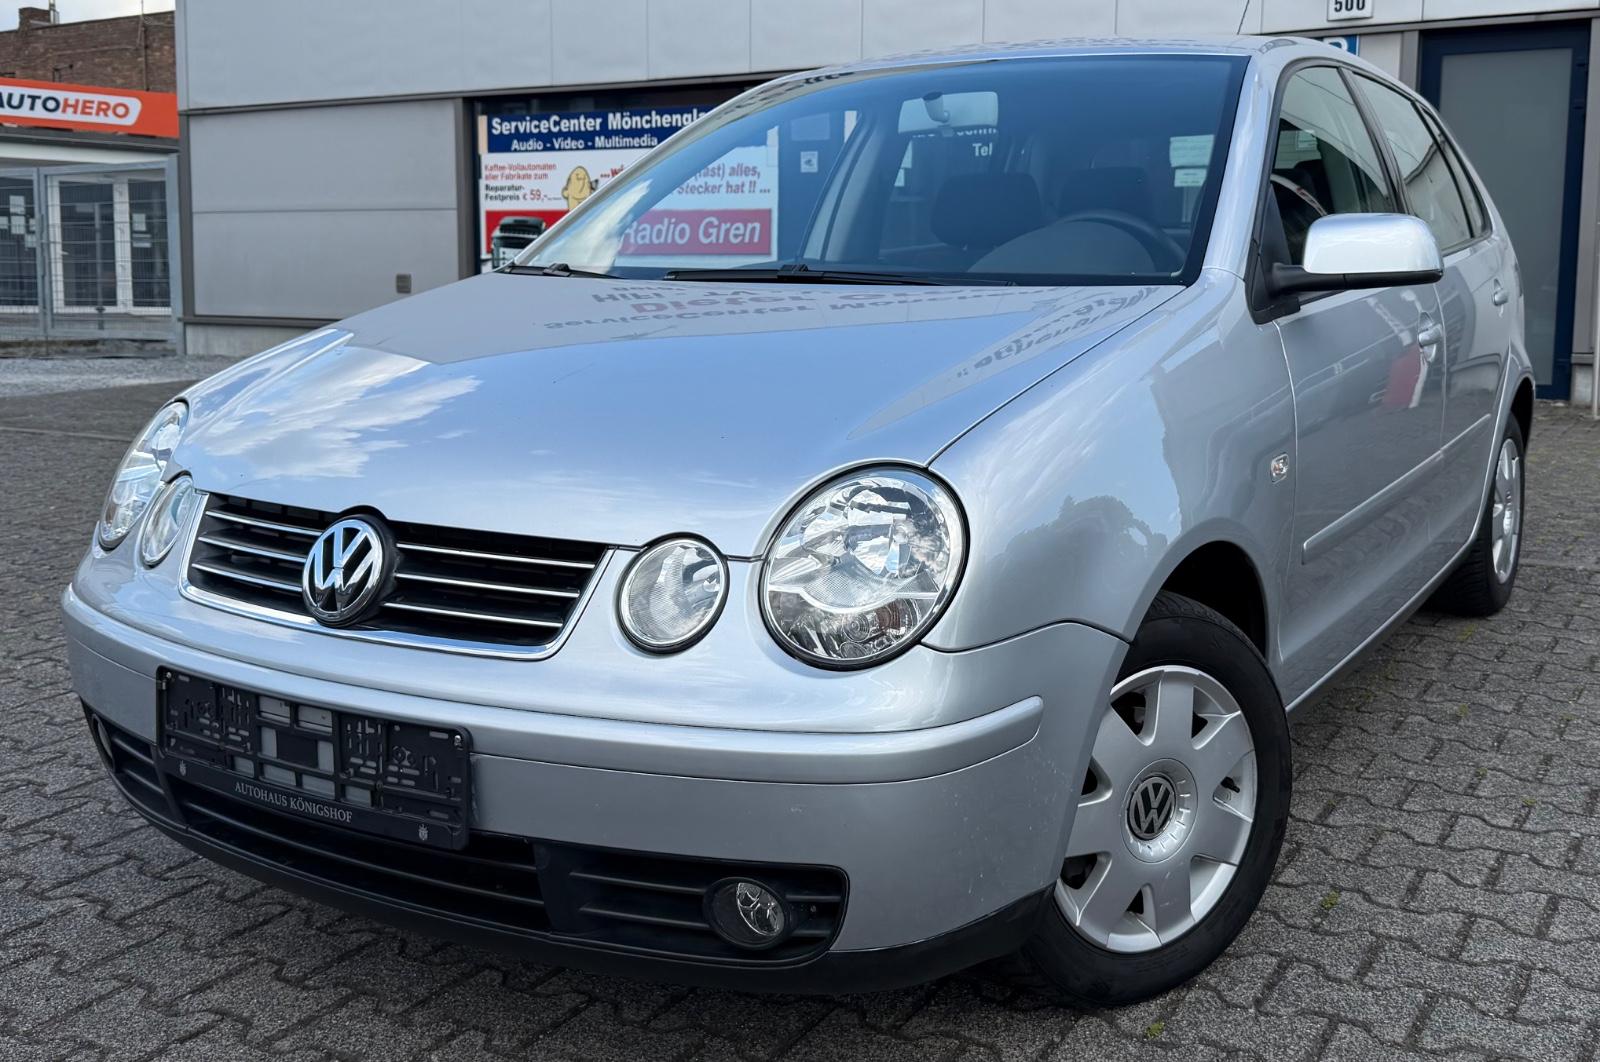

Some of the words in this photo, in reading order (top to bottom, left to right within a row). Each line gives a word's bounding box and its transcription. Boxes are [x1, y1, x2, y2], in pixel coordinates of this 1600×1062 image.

[491, 115, 603, 135] ServiceCenter
[511, 138, 544, 151] Audio
[552, 137, 585, 150] Video
[594, 134, 658, 148] Multimedia
[694, 162, 725, 182] ast)
[728, 163, 761, 179] alles,
[485, 193, 520, 202] Festpreis
[677, 181, 723, 195] Stecker
[725, 180, 745, 194] hat
[699, 216, 761, 245] Gren
[235, 782, 287, 807] AUTOHAUS
[290, 797, 352, 822] KÖNIGSHOF
